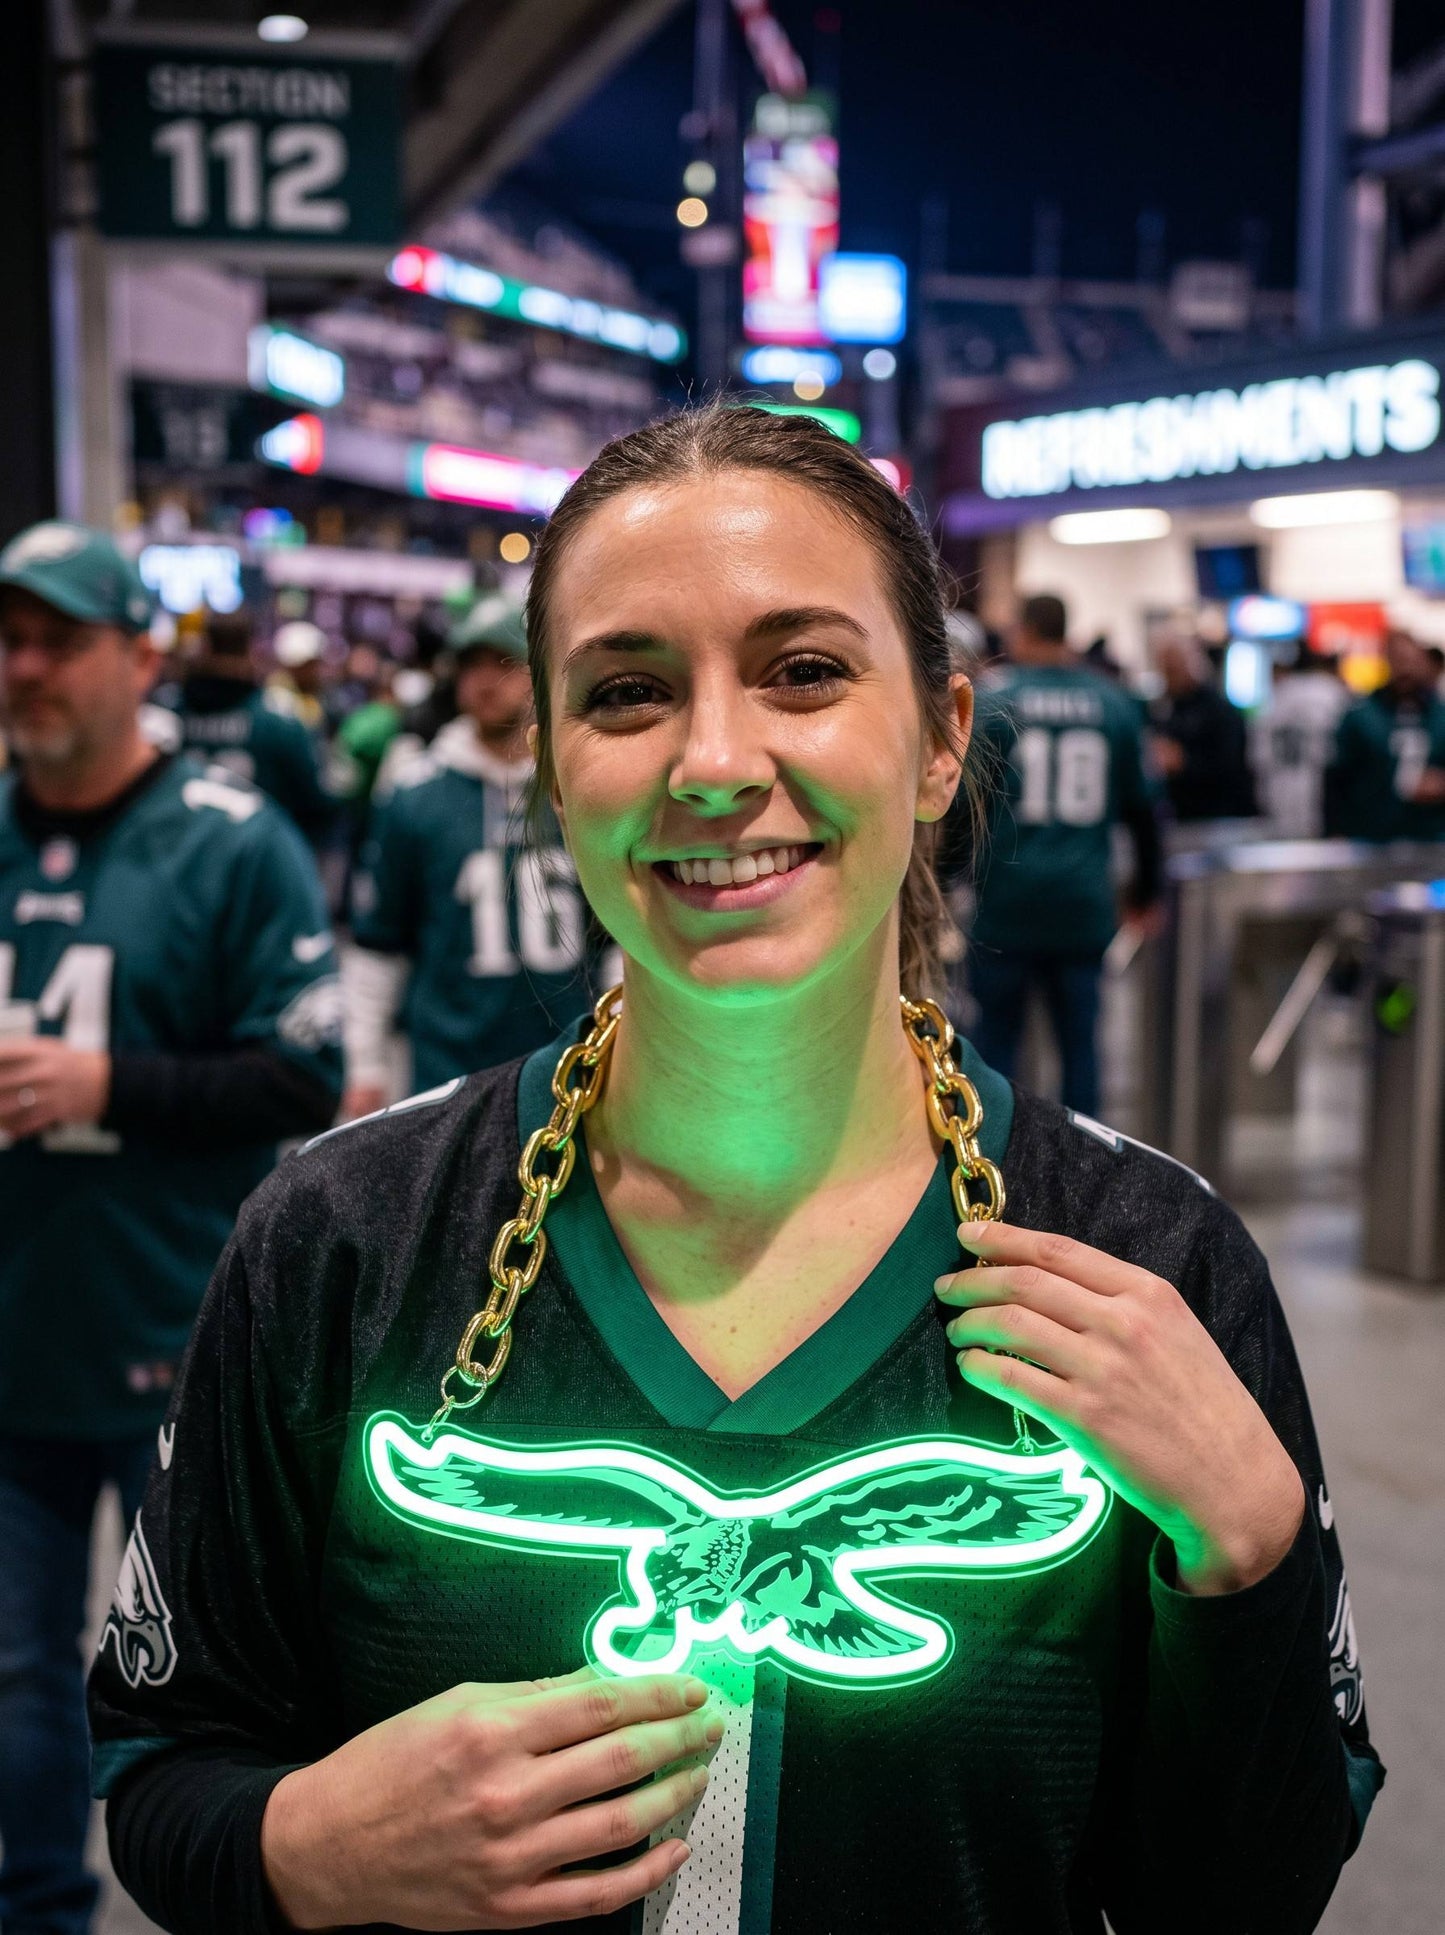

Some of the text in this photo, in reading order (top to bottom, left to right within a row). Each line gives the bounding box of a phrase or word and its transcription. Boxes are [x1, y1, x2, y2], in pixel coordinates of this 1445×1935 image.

[149, 65, 350, 117] SECTION
[152, 118, 350, 232] 112
[454, 846, 584, 977] 16
